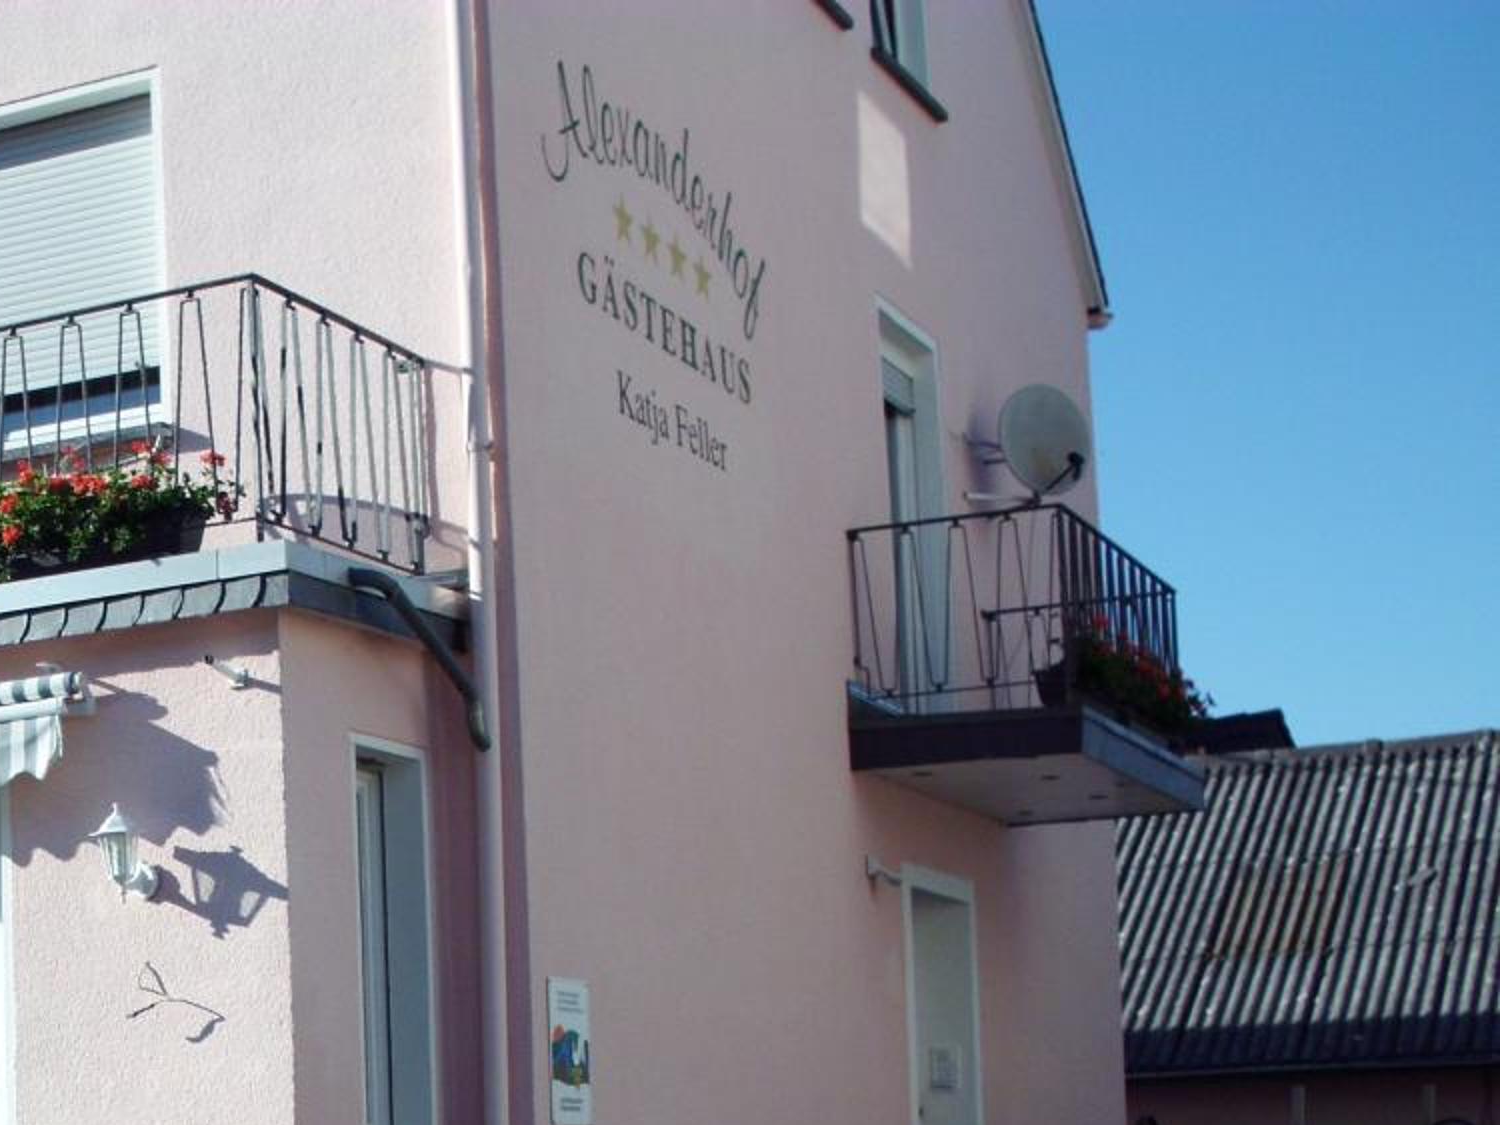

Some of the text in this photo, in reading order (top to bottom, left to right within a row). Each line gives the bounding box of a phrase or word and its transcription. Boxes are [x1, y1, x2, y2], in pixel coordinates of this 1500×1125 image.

[540, 59, 766, 340] Alexanderhof
[578, 251, 750, 405] GÄSTEHAUS
[617, 369, 669, 446] Katja
